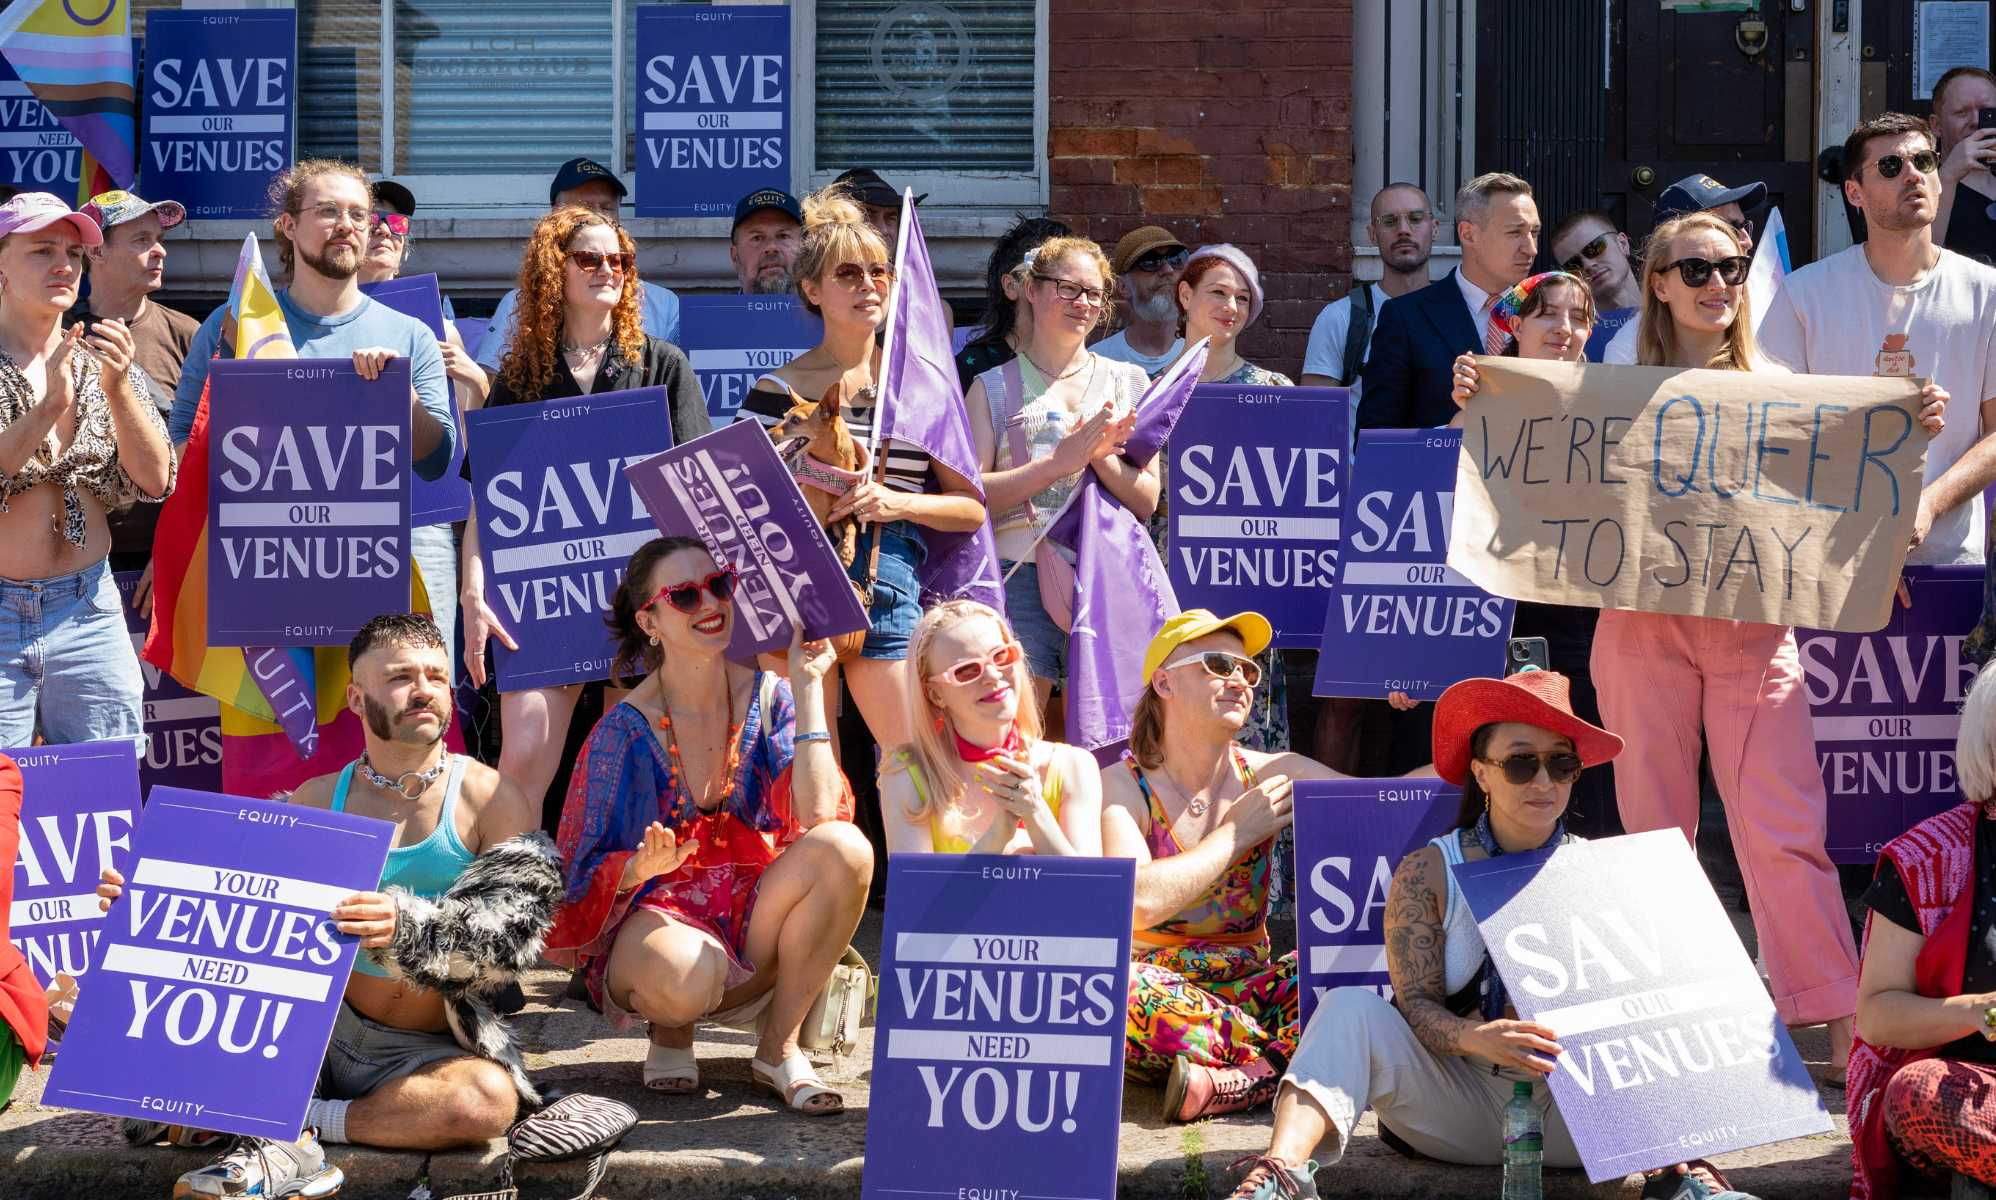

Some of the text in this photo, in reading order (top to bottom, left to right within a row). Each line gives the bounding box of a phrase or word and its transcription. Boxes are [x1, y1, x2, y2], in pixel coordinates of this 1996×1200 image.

[202, 15, 240, 25] EQUITY
[695, 12, 733, 22] EQUITY
[151, 58, 287, 109] SAVE
[644, 55, 783, 105] SAVE
[0, 99, 59, 127] VEN
[202, 117, 233, 132] OUR
[697, 113, 730, 129] OUR
[7, 149, 81, 184] YOU
[150, 140, 285, 172] VENUES
[644, 137, 783, 169] VENUES
[196, 206, 233, 215] EQUITY
[693, 203, 732, 213] EQUITY
[747, 301, 791, 311] EQUITY
[745, 350, 794, 367] YOUR
[287, 368, 336, 379] EQUITY
[1238, 393, 1282, 404] EQUITY
[542, 405, 592, 421] EQUITY
[1426, 438, 1462, 448] EQUIT
[1480, 394, 1913, 519] WE'RE QUEER
[219, 425, 401, 493] SAVE
[1178, 444, 1340, 508] SAVE
[289, 505, 331, 524] OUR
[792, 497, 825, 549] EQUITY
[1240, 519, 1279, 537] OUR
[1350, 490, 1455, 553] SAV
[674, 456, 785, 638] VENUES
[697, 524, 729, 568] OUR
[721, 463, 813, 603] YOU!
[735, 513, 770, 567] NEED
[219, 536, 400, 580] VENUES
[563, 539, 607, 561] OUR
[1541, 516, 1811, 601] TO STAY
[1179, 546, 1339, 588] VENUES
[1406, 565, 1446, 584] OUR
[497, 567, 628, 624] VENU
[1341, 594, 1505, 638] VENUES
[284, 625, 334, 637] EQUITY
[574, 657, 614, 673] EQUIT
[252, 647, 320, 746] UITY
[1384, 679, 1430, 691] EQUITY
[1868, 718, 1912, 738] OUR
[16, 754, 60, 768] QUITY
[144, 726, 224, 771] UES
[1819, 751, 1957, 795] ENUE
[1378, 789, 1432, 802] EQUITY
[237, 809, 299, 828] EQUITY
[14, 810, 133, 887] AVE
[212, 870, 281, 899] YOUR
[981, 866, 1044, 881] EQUITY
[1309, 855, 1394, 934] SA
[28, 899, 73, 922] OUR
[128, 889, 343, 967] VENUES
[972, 938, 1039, 962] YOUR
[1504, 907, 1664, 999] SAV
[182, 957, 249, 985] NEED
[894, 967, 1115, 1027] VENUES
[1620, 991, 1676, 1021] OUR
[125, 980, 294, 1059] YOU!
[966, 1035, 1031, 1060] NEED
[1557, 1011, 1782, 1097] VENUES
[140, 1095, 206, 1117] EQUITY
[916, 1065, 1081, 1134] YOU!
[1678, 1124, 1740, 1149] EQUITY
[958, 1187, 1020, 1200] EQUITY
